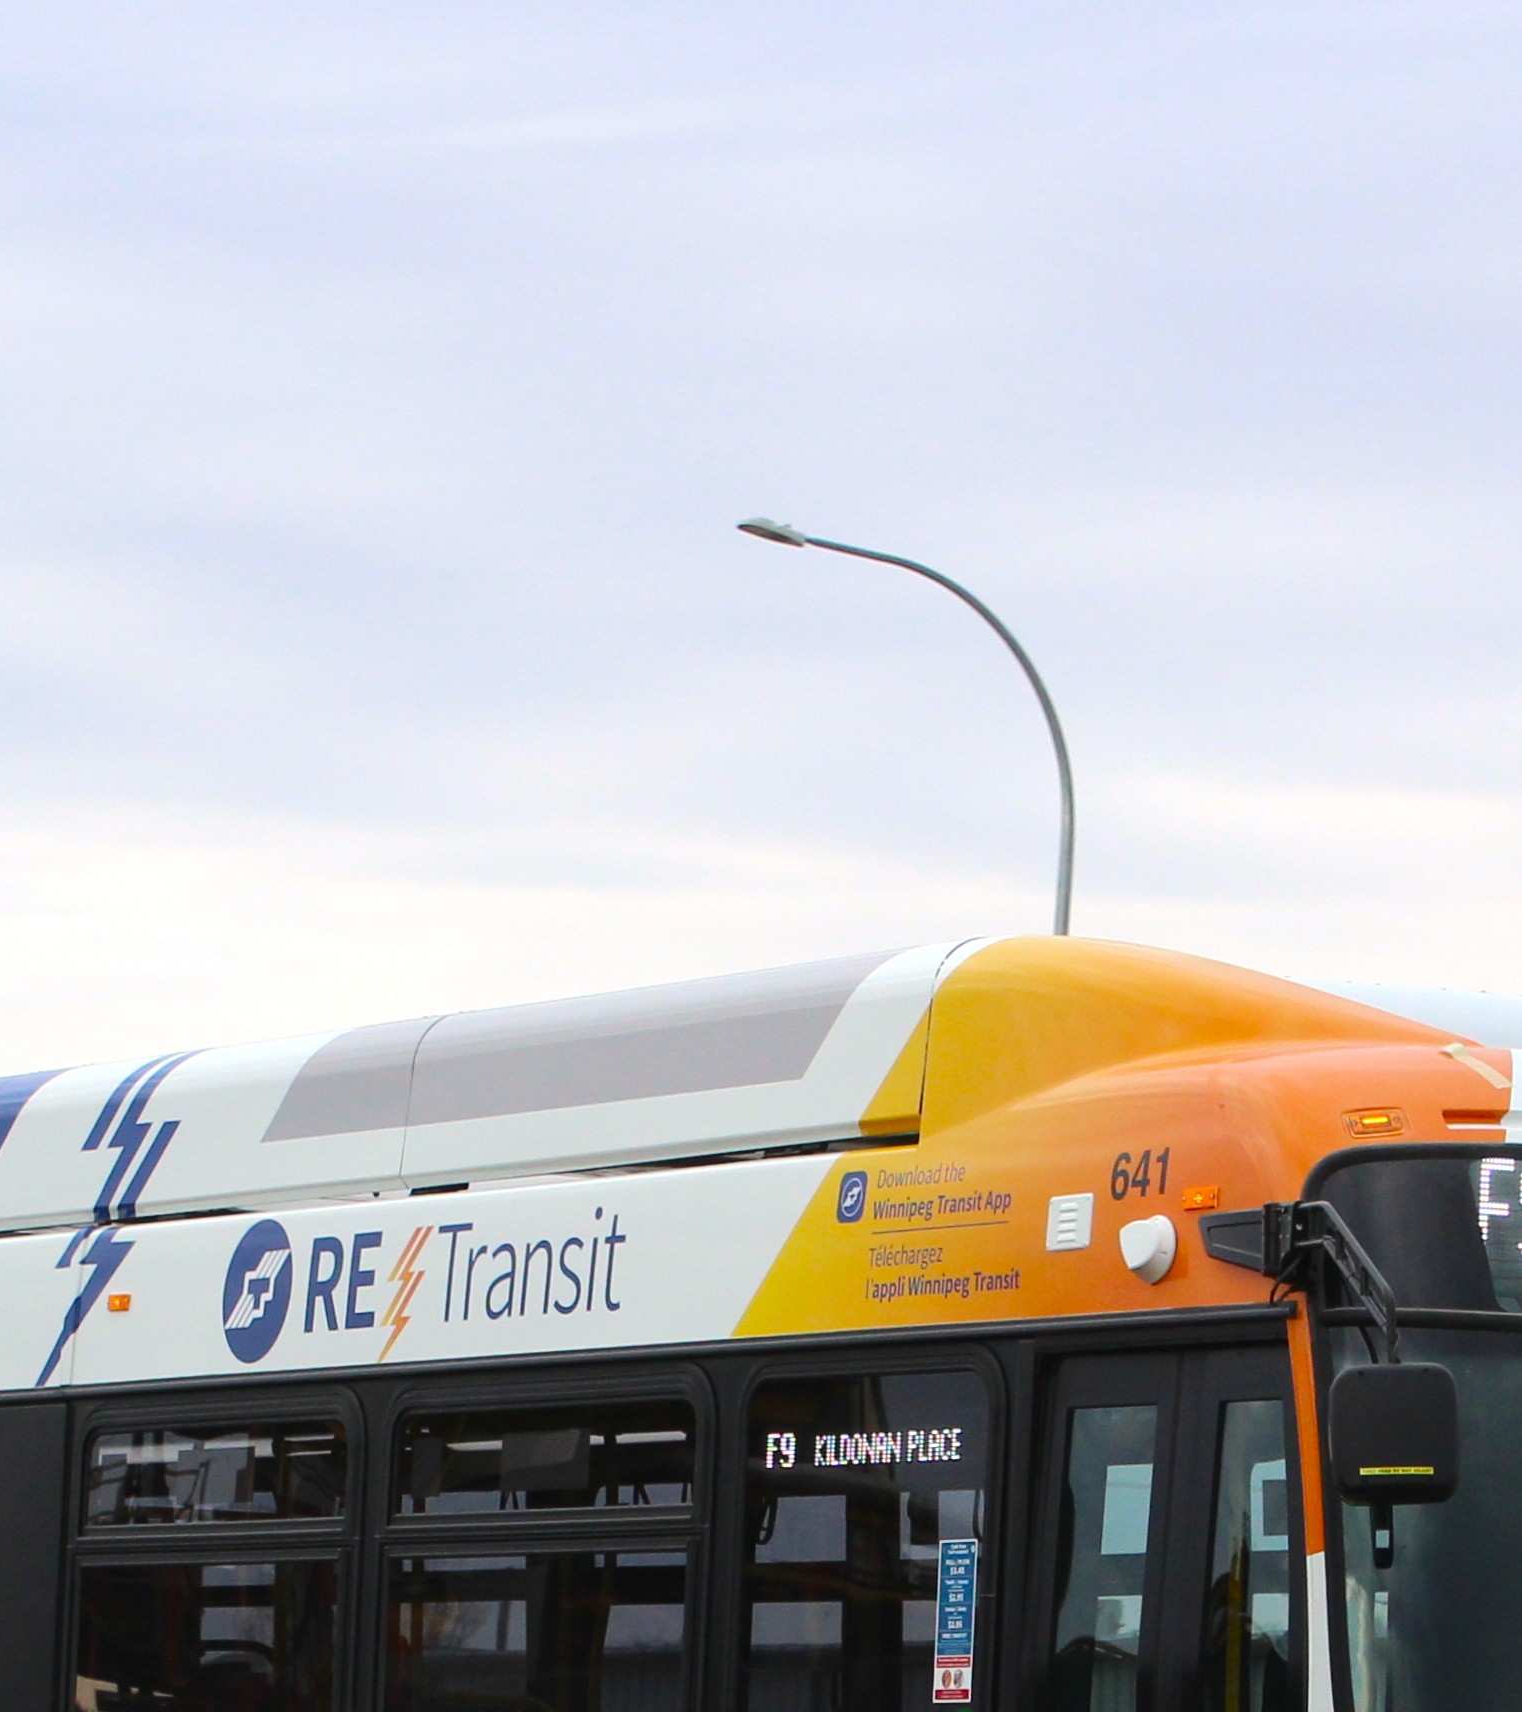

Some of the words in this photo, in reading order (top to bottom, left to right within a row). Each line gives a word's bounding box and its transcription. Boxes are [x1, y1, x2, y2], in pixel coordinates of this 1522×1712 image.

[877, 1164, 943, 1189] Download
[944, 1161, 966, 1183] the
[1111, 1147, 1170, 1201] 641
[873, 1197, 935, 1222] Winnipeg
[937, 1190, 982, 1215] Transit
[984, 1190, 1012, 1215] App
[303, 1230, 383, 1334] RE
[438, 1206, 627, 1323] Transit
[869, 1243, 943, 1270] Téléchargez
[865, 1275, 906, 1303] l'appli
[908, 1273, 970, 1299] Winnipeg
[974, 1268, 1021, 1292] Transit
[766, 1432, 796, 1469] F9
[814, 1431, 902, 1467] KILDONAN
[906, 1428, 962, 1462] PLACE
